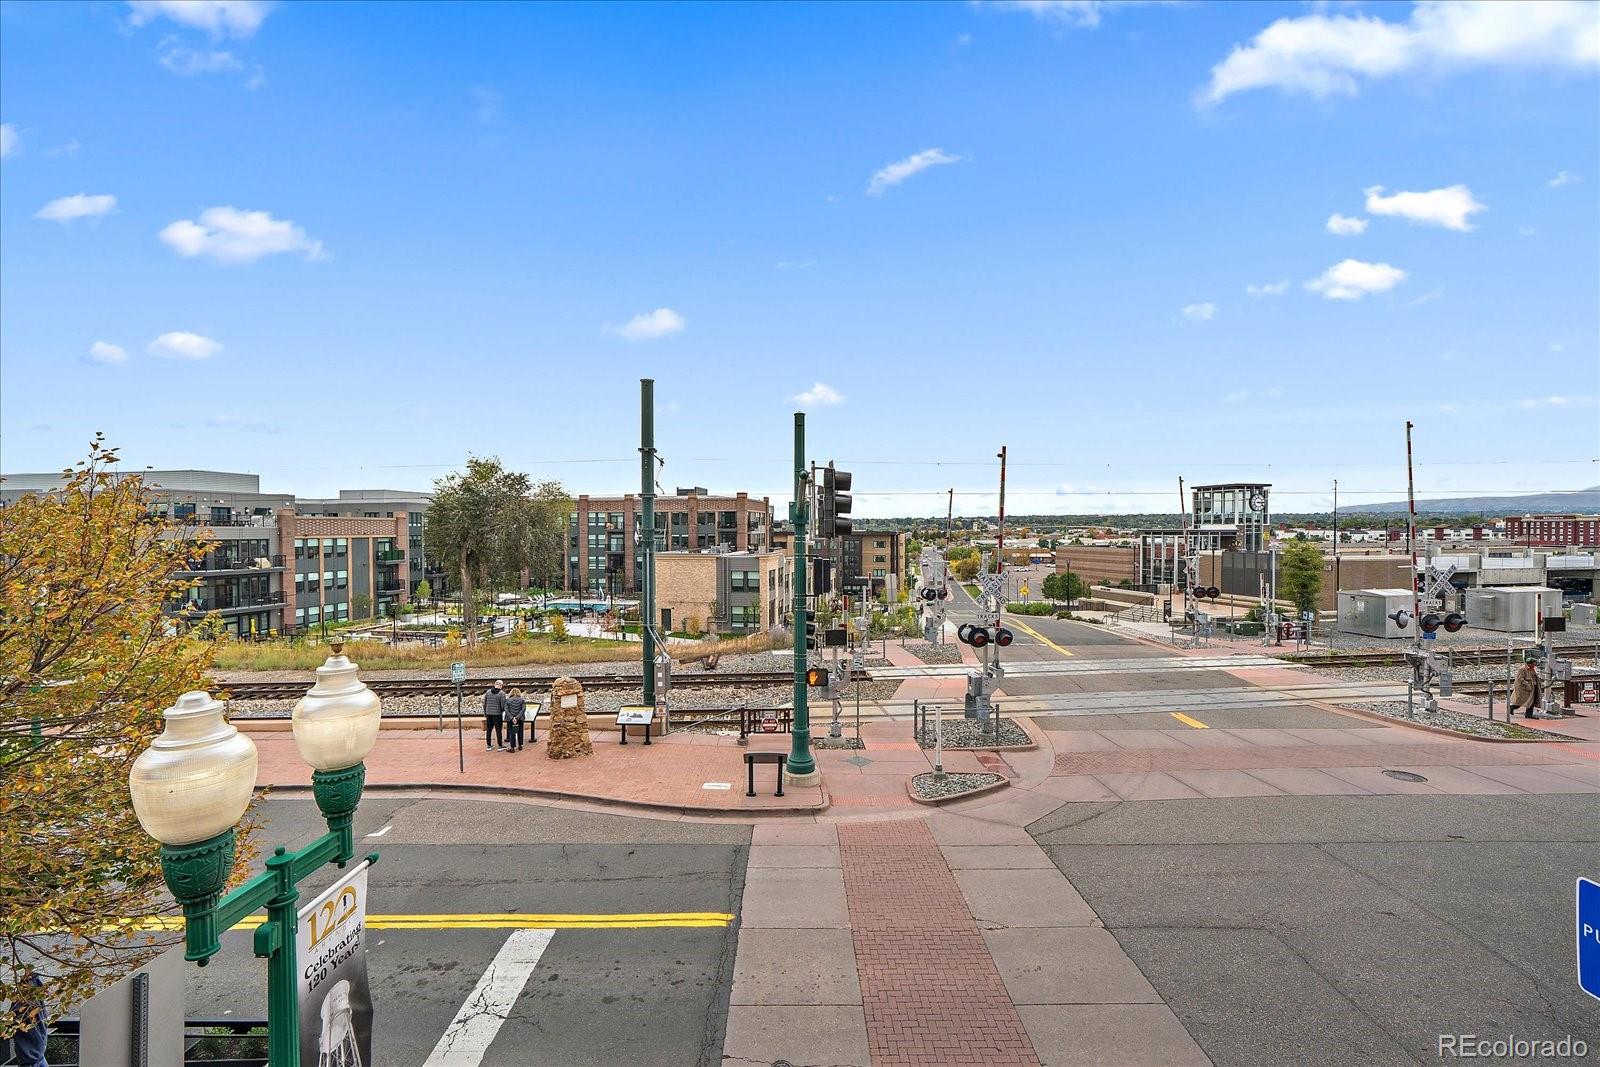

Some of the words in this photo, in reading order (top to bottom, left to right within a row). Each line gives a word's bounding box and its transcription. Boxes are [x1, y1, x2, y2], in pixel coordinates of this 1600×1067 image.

[977, 572, 1008, 604] CROSSING
[978, 571, 990, 587] RAIL
[1431, 565, 1457, 596] CROSSING
[304, 921, 362, 980] Celebrating
[307, 967, 328, 993] 120
